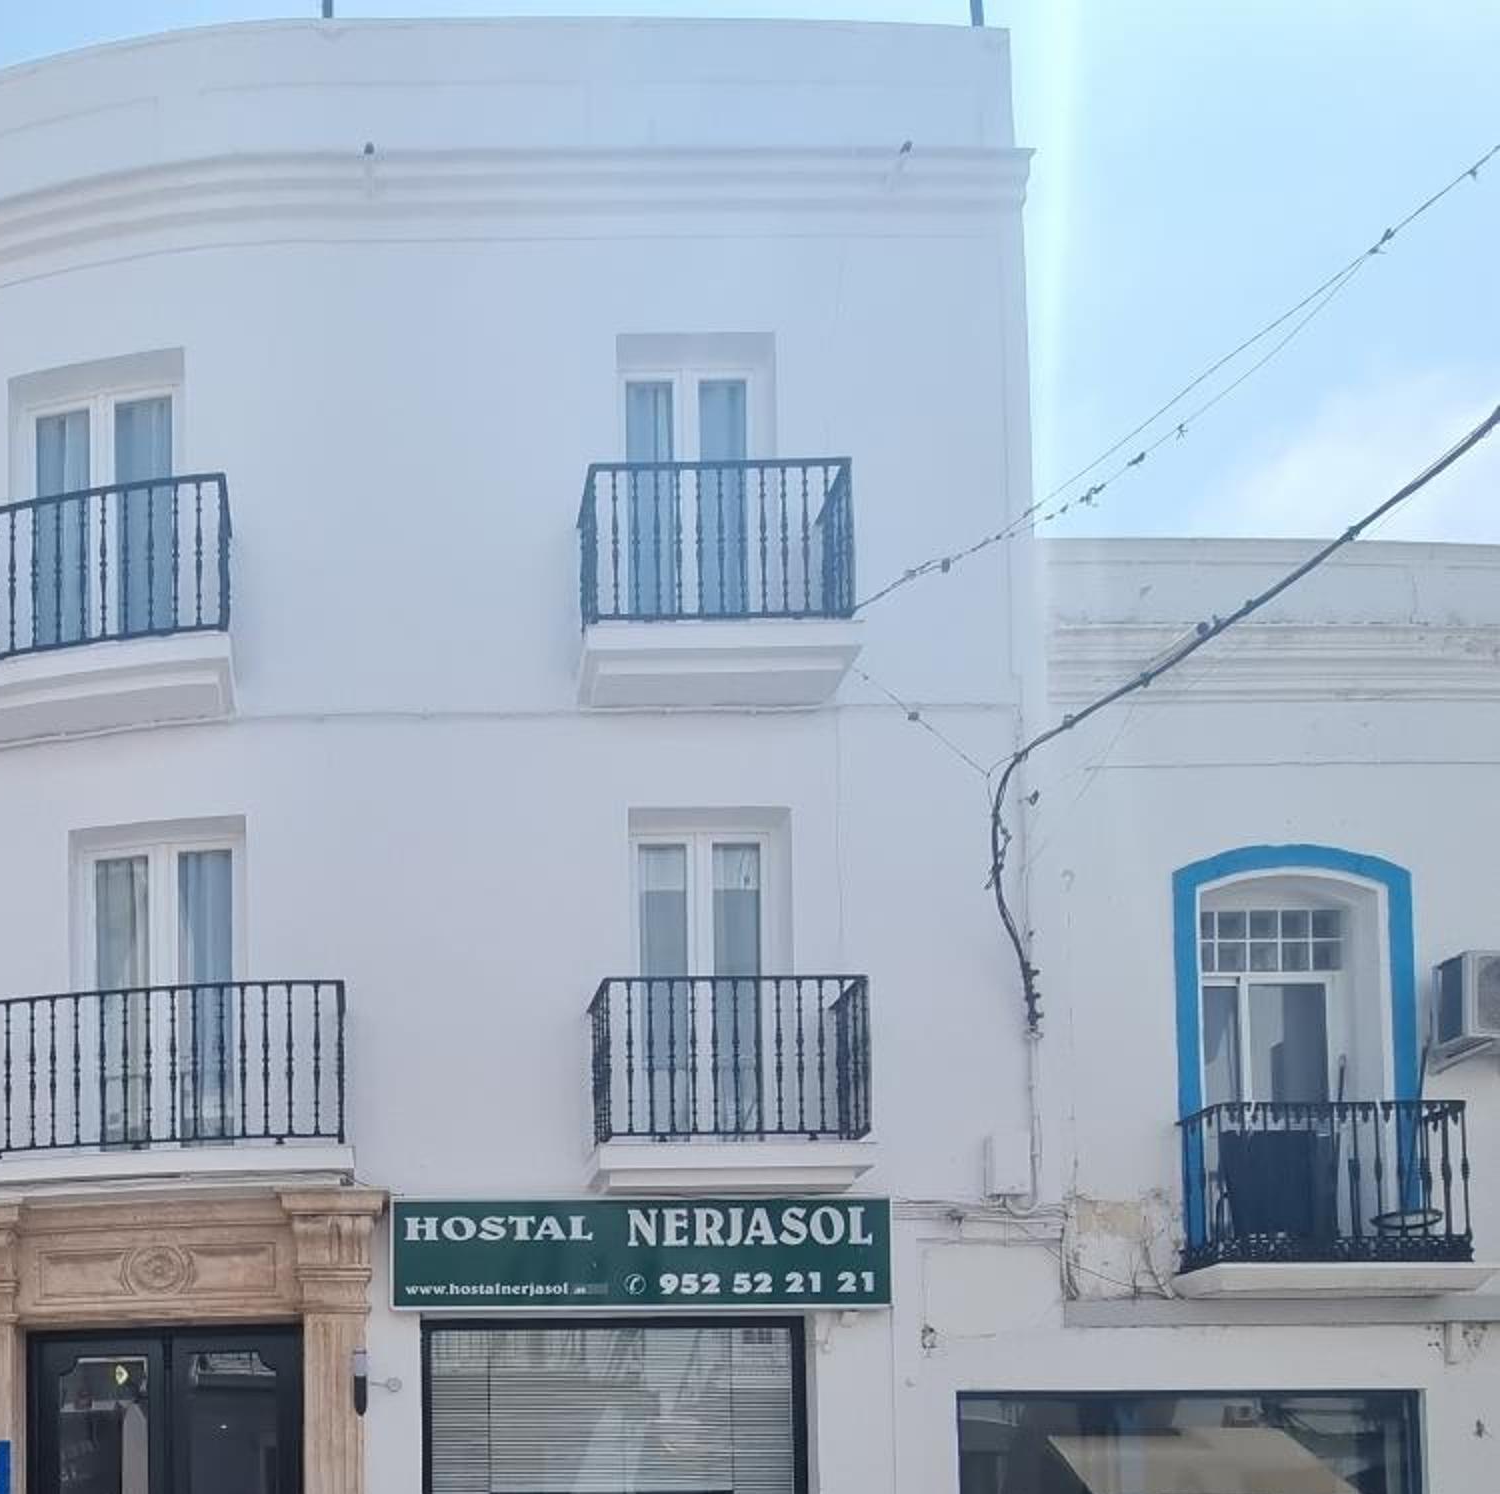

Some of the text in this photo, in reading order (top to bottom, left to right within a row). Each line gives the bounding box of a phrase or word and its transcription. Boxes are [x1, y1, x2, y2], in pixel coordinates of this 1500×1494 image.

[404, 1206, 873, 1247] HOSTAL NERJASOL
[659, 1273, 721, 1295] 952
[732, 1272, 773, 1295] 52
[785, 1271, 822, 1294] 21
[837, 1271, 875, 1293] 21
